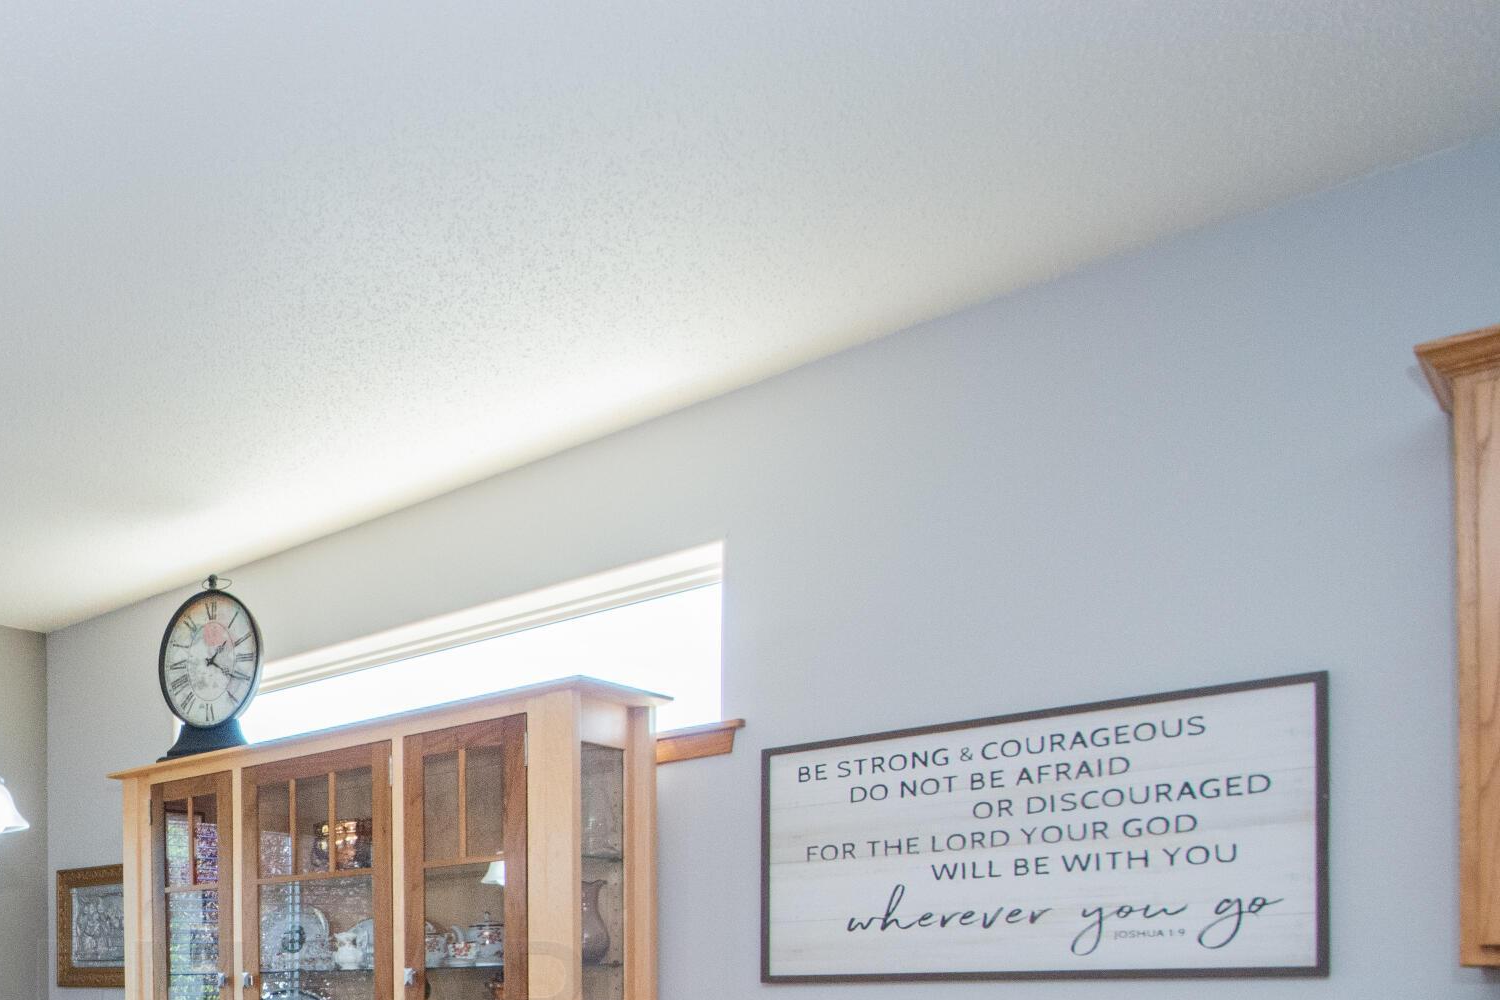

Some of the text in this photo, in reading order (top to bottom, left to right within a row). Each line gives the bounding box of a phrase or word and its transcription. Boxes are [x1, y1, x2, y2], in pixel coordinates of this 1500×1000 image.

[797, 715, 1207, 784] BE STRONG & COURAGEOUS
[849, 756, 1131, 804] DO NOT BE AFRAID
[972, 773, 1272, 820] OR DISCOURAGED
[806, 813, 1199, 863] FOR THE LORD YOUR GOD
[930, 843, 1238, 881] WILL BE WITH YOU
[846, 883, 1285, 956] wherever you go
[1114, 928, 1165, 941] JOSHUA
